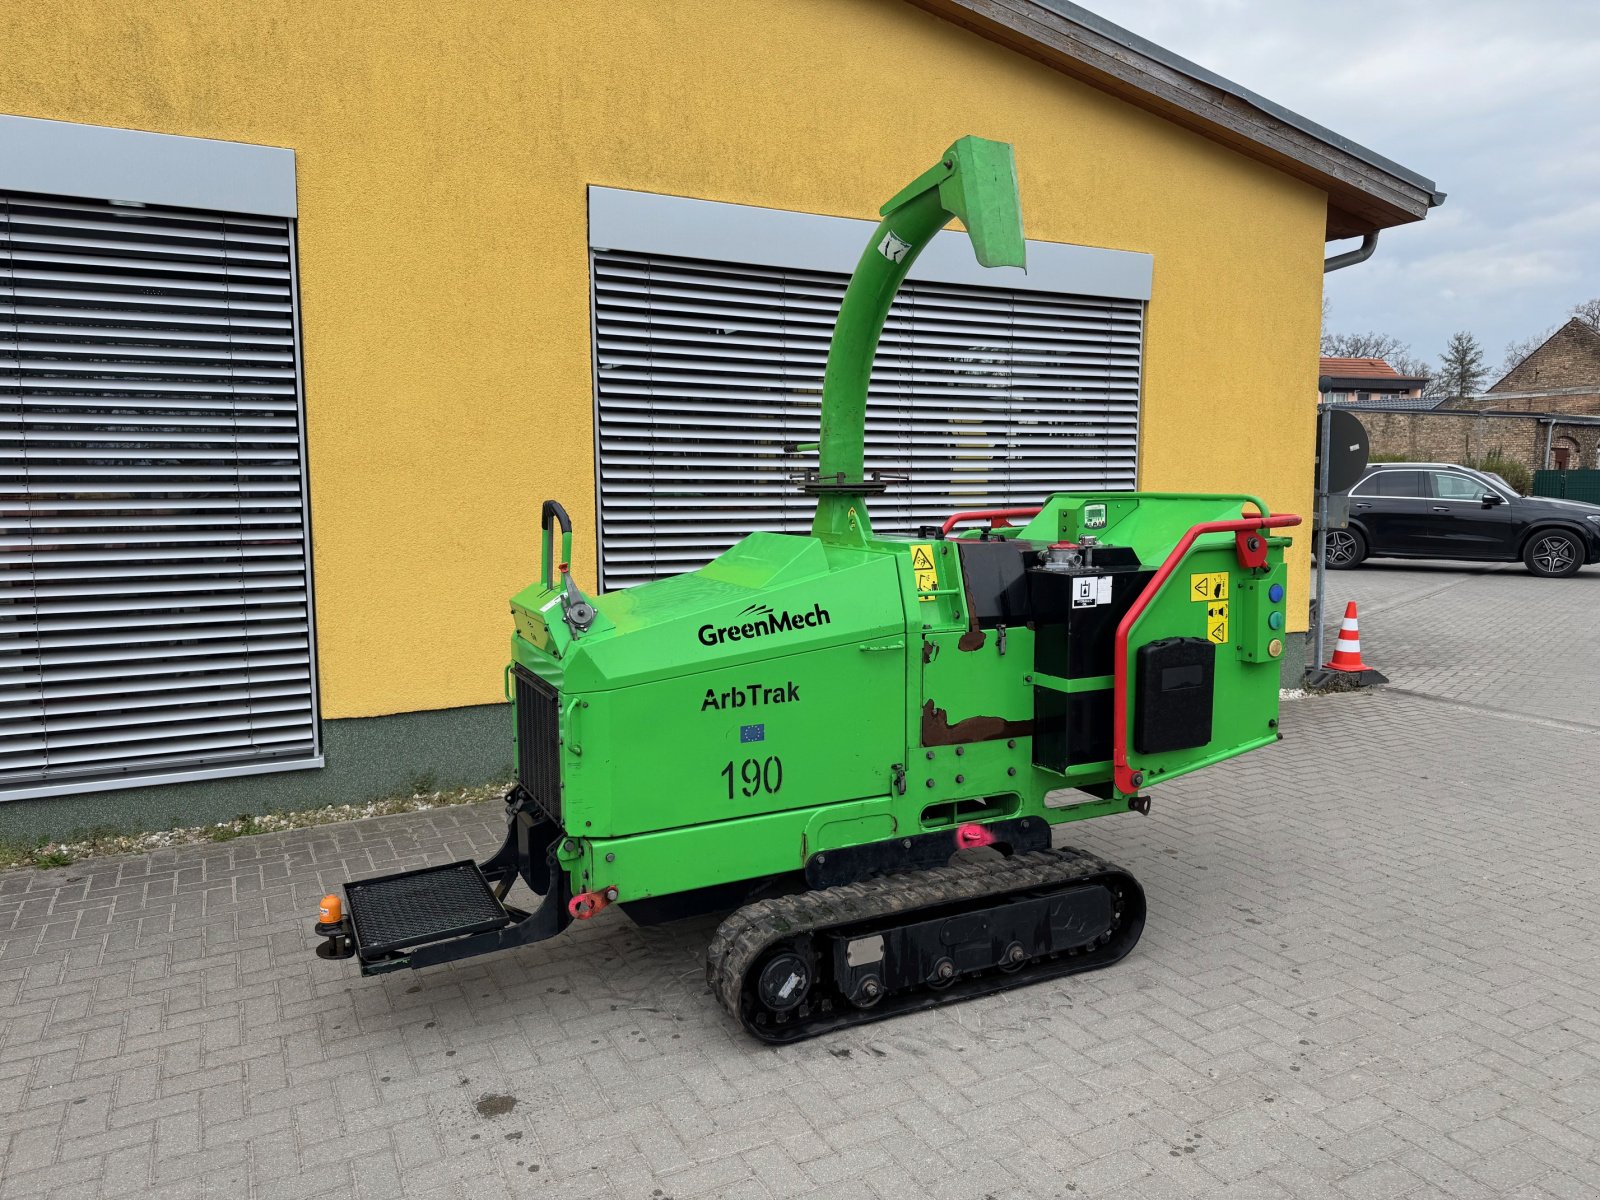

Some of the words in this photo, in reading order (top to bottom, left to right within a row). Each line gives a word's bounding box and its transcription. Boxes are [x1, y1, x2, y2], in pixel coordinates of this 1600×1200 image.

[698, 603, 831, 647] GreenMech
[701, 681, 800, 711] ArbTrak
[721, 755, 783, 800] 190
